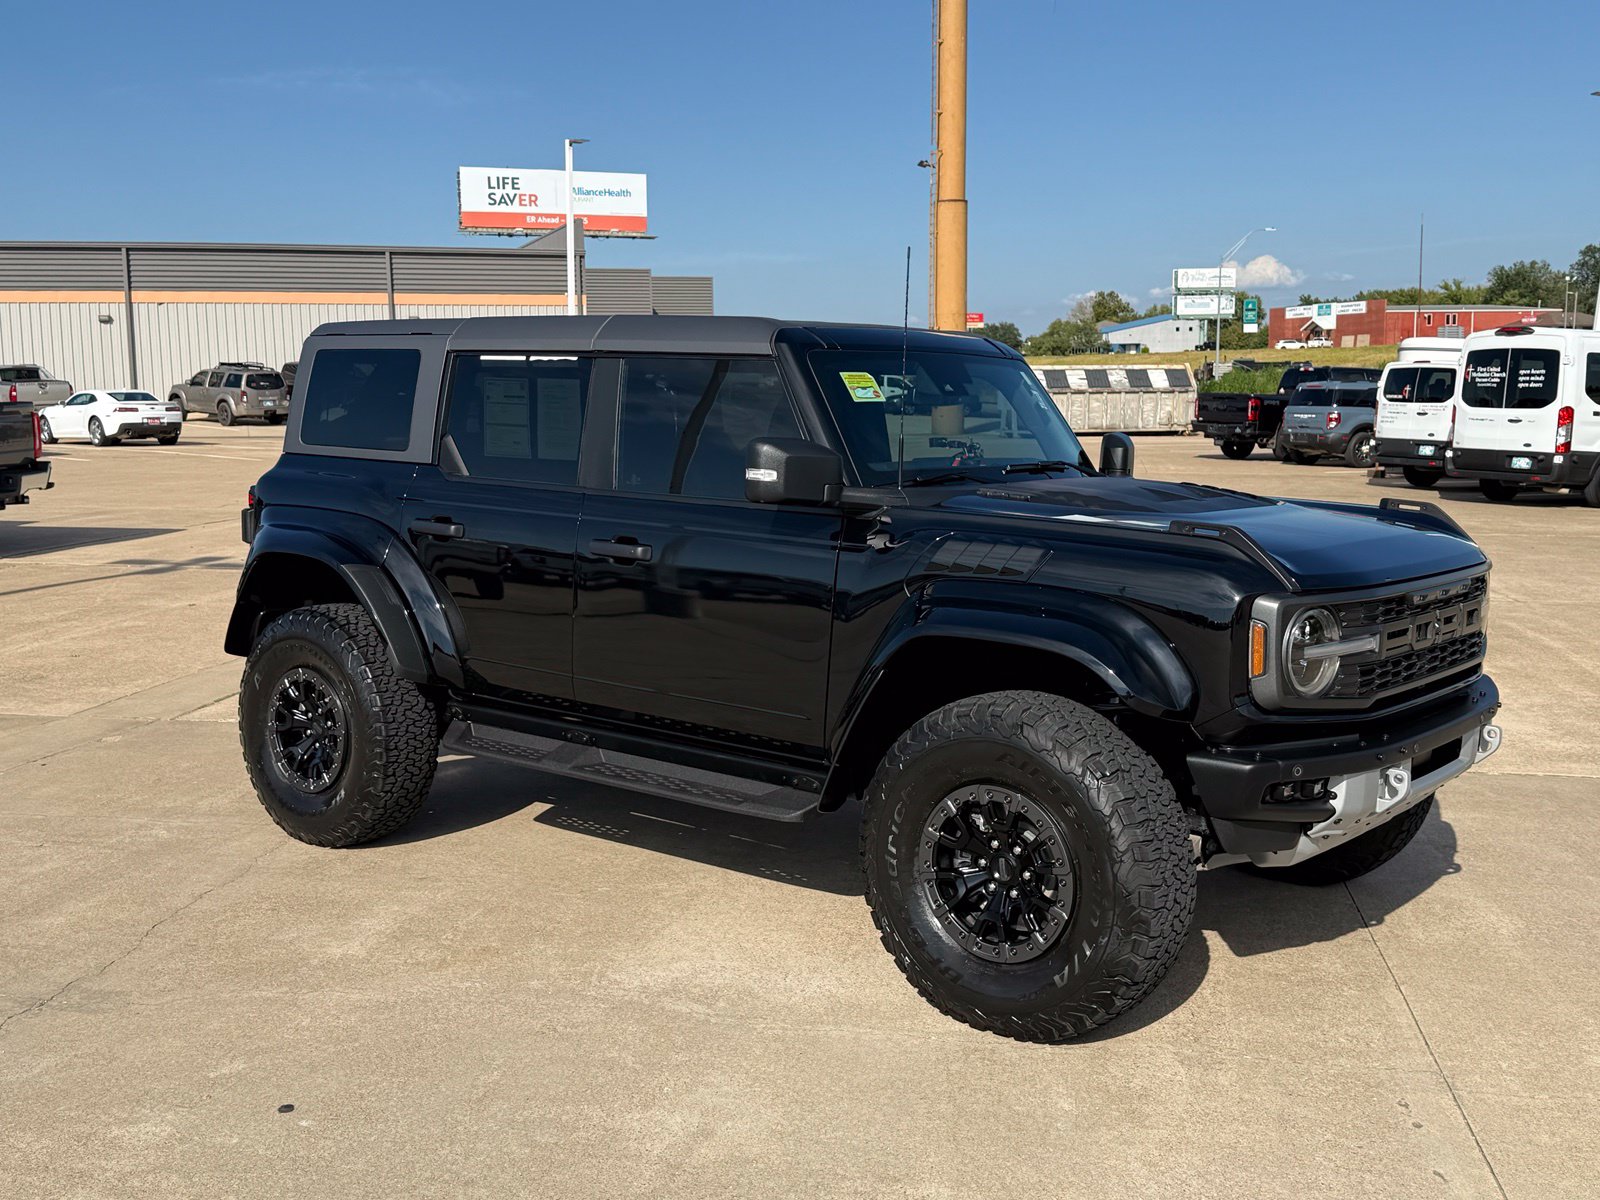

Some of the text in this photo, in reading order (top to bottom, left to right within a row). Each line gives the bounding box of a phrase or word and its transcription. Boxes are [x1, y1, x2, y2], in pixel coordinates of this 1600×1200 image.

[487, 176, 520, 190] LIFE
[488, 192, 538, 207] SAVER
[526, 215, 536, 223] ER
[537, 215, 559, 223] Ahead
[1381, 599, 1481, 660] FORD
[1053, 940, 1097, 990] T/A
